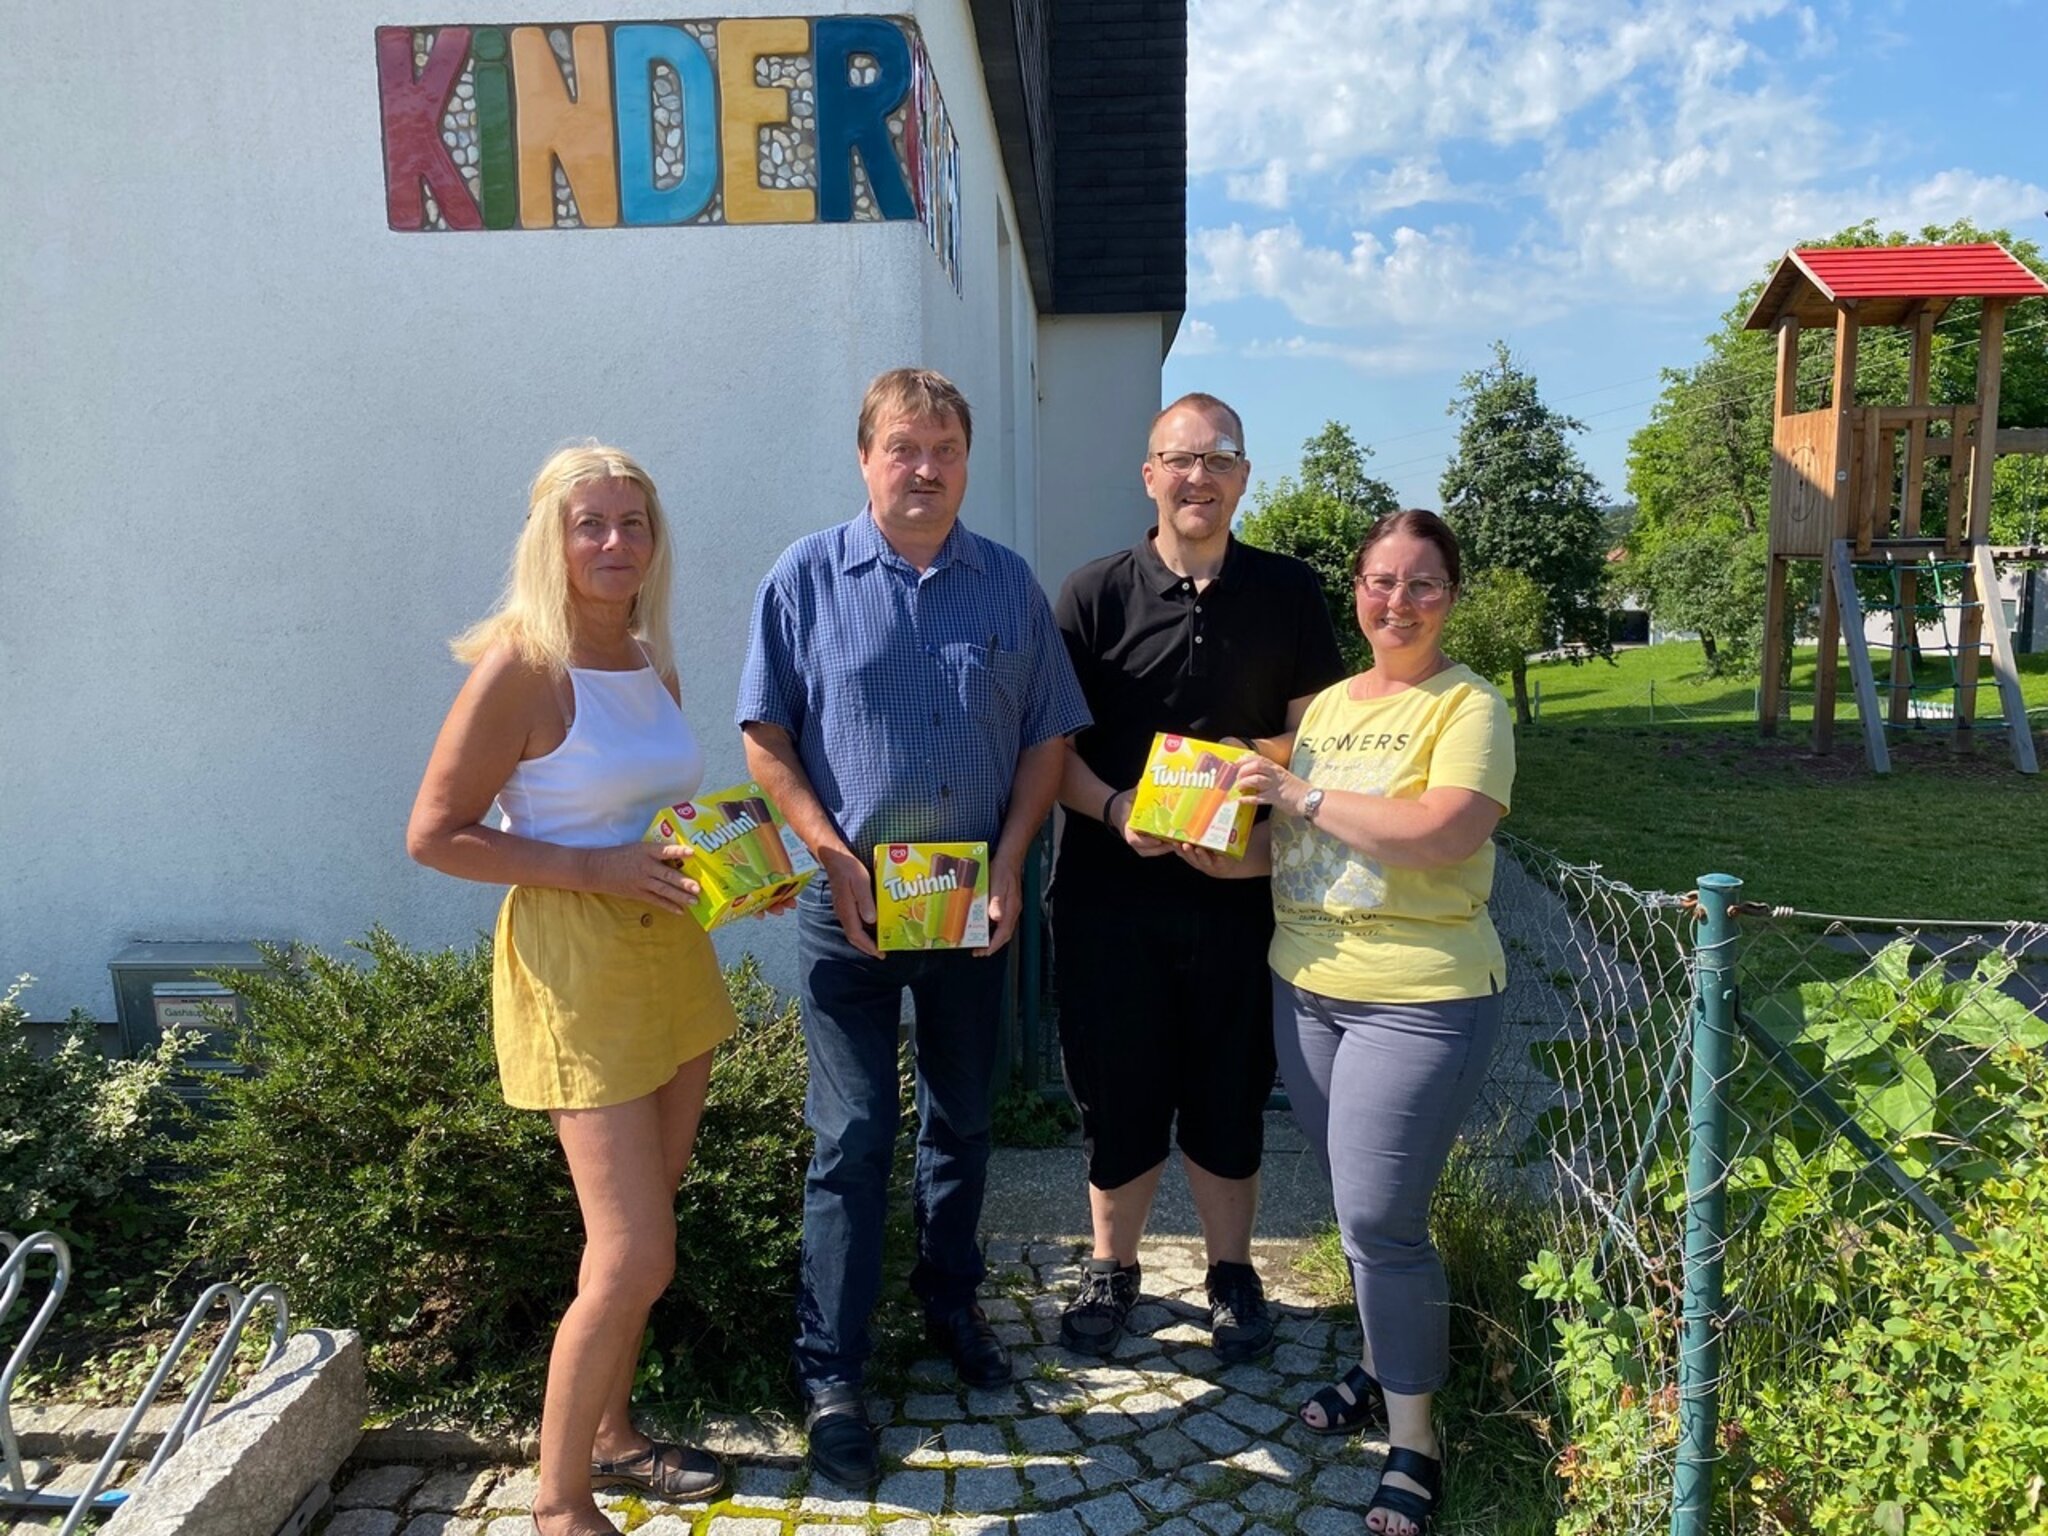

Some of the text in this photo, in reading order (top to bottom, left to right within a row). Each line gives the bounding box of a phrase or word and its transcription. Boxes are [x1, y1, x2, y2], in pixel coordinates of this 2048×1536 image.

[1297, 732, 1410, 754] FLOWERS
[1150, 764, 1218, 789] Twinni
[690, 810, 760, 854] Twinni
[884, 868, 958, 901] Twinni
